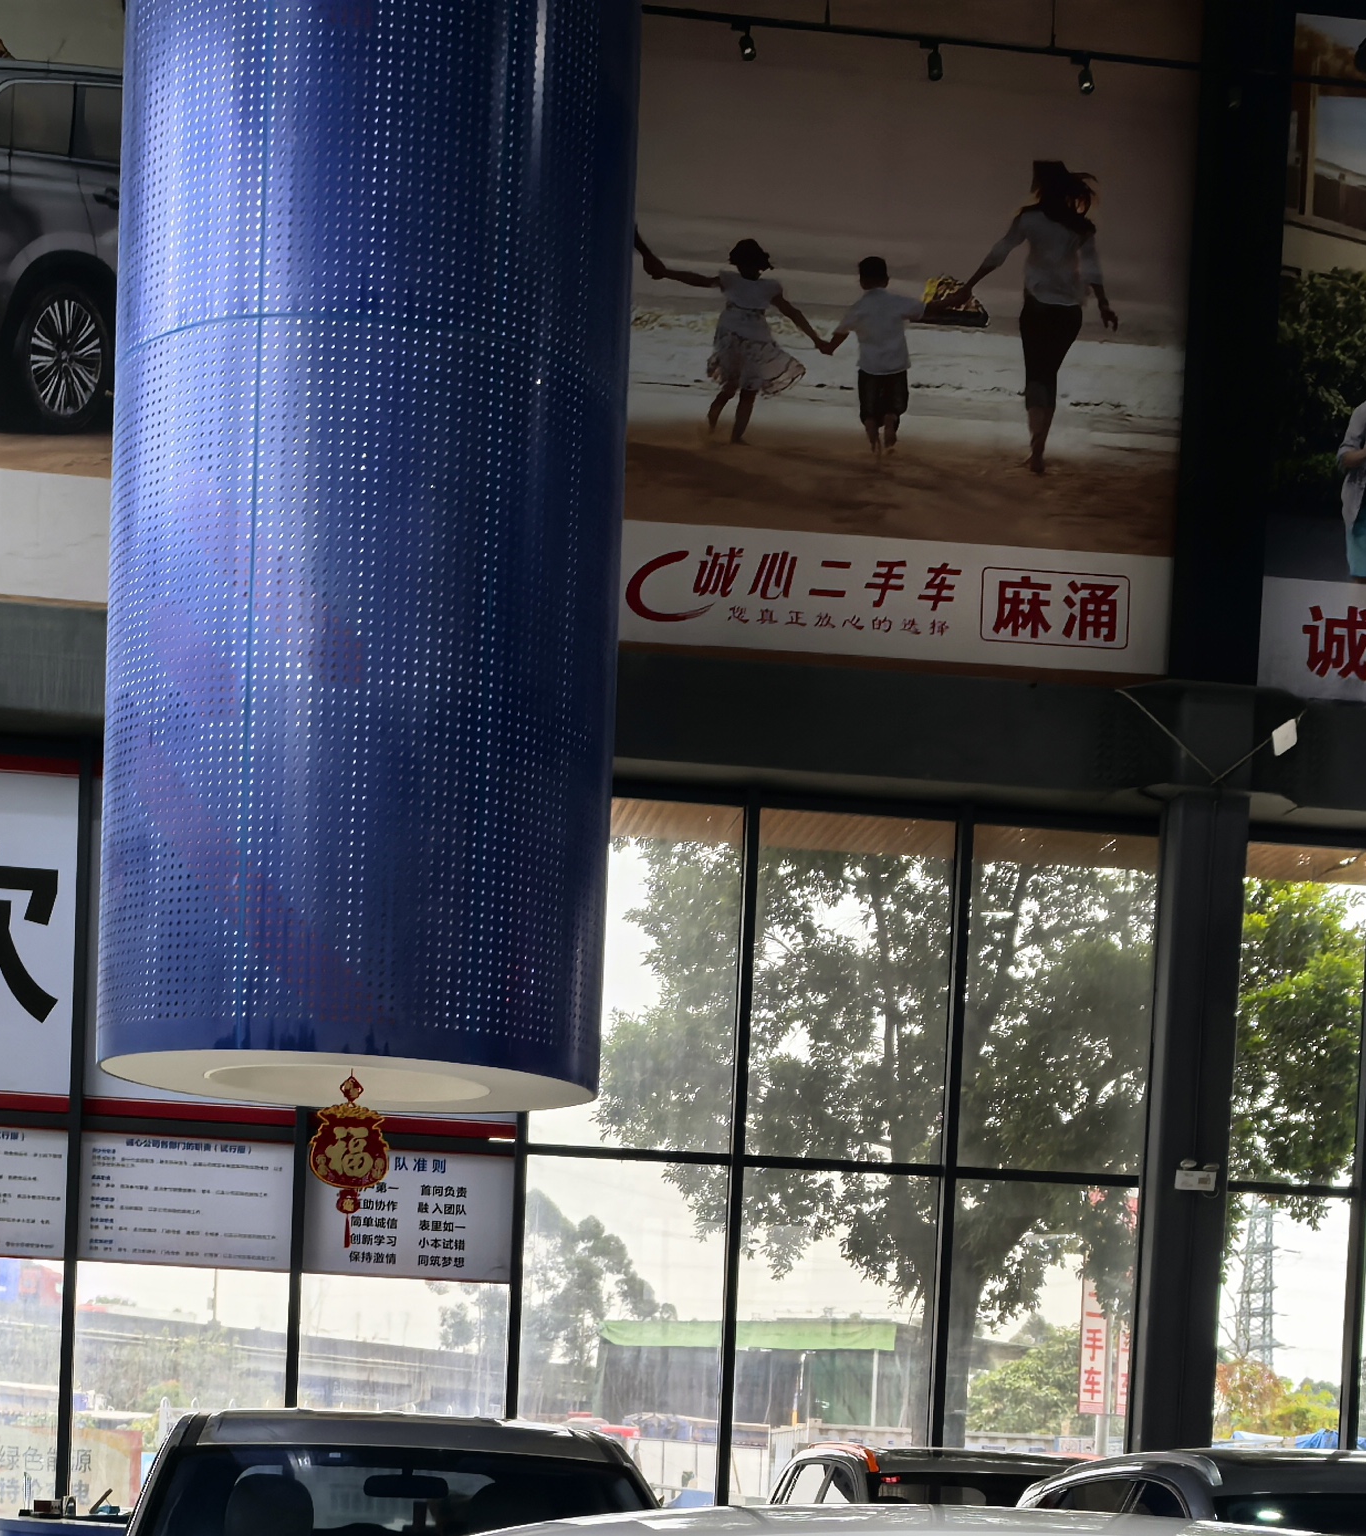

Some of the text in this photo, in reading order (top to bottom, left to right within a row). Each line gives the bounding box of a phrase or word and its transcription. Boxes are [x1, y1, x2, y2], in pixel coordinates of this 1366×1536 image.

[692, 544, 1119, 643] 诚心二手车 麻涌
[726, 604, 951, 637] 您真正放心的选择
[324, 1126, 375, 1179] 福
[389, 1155, 447, 1174] 队准则
[420, 1183, 468, 1199] 首问负责
[417, 1201, 468, 1217] 融入团队
[350, 1215, 467, 1233] 简单诚信 表里如一
[349, 1232, 466, 1252] 创新学习 小本试错
[348, 1250, 466, 1269] 保持激情 同筑梦想
